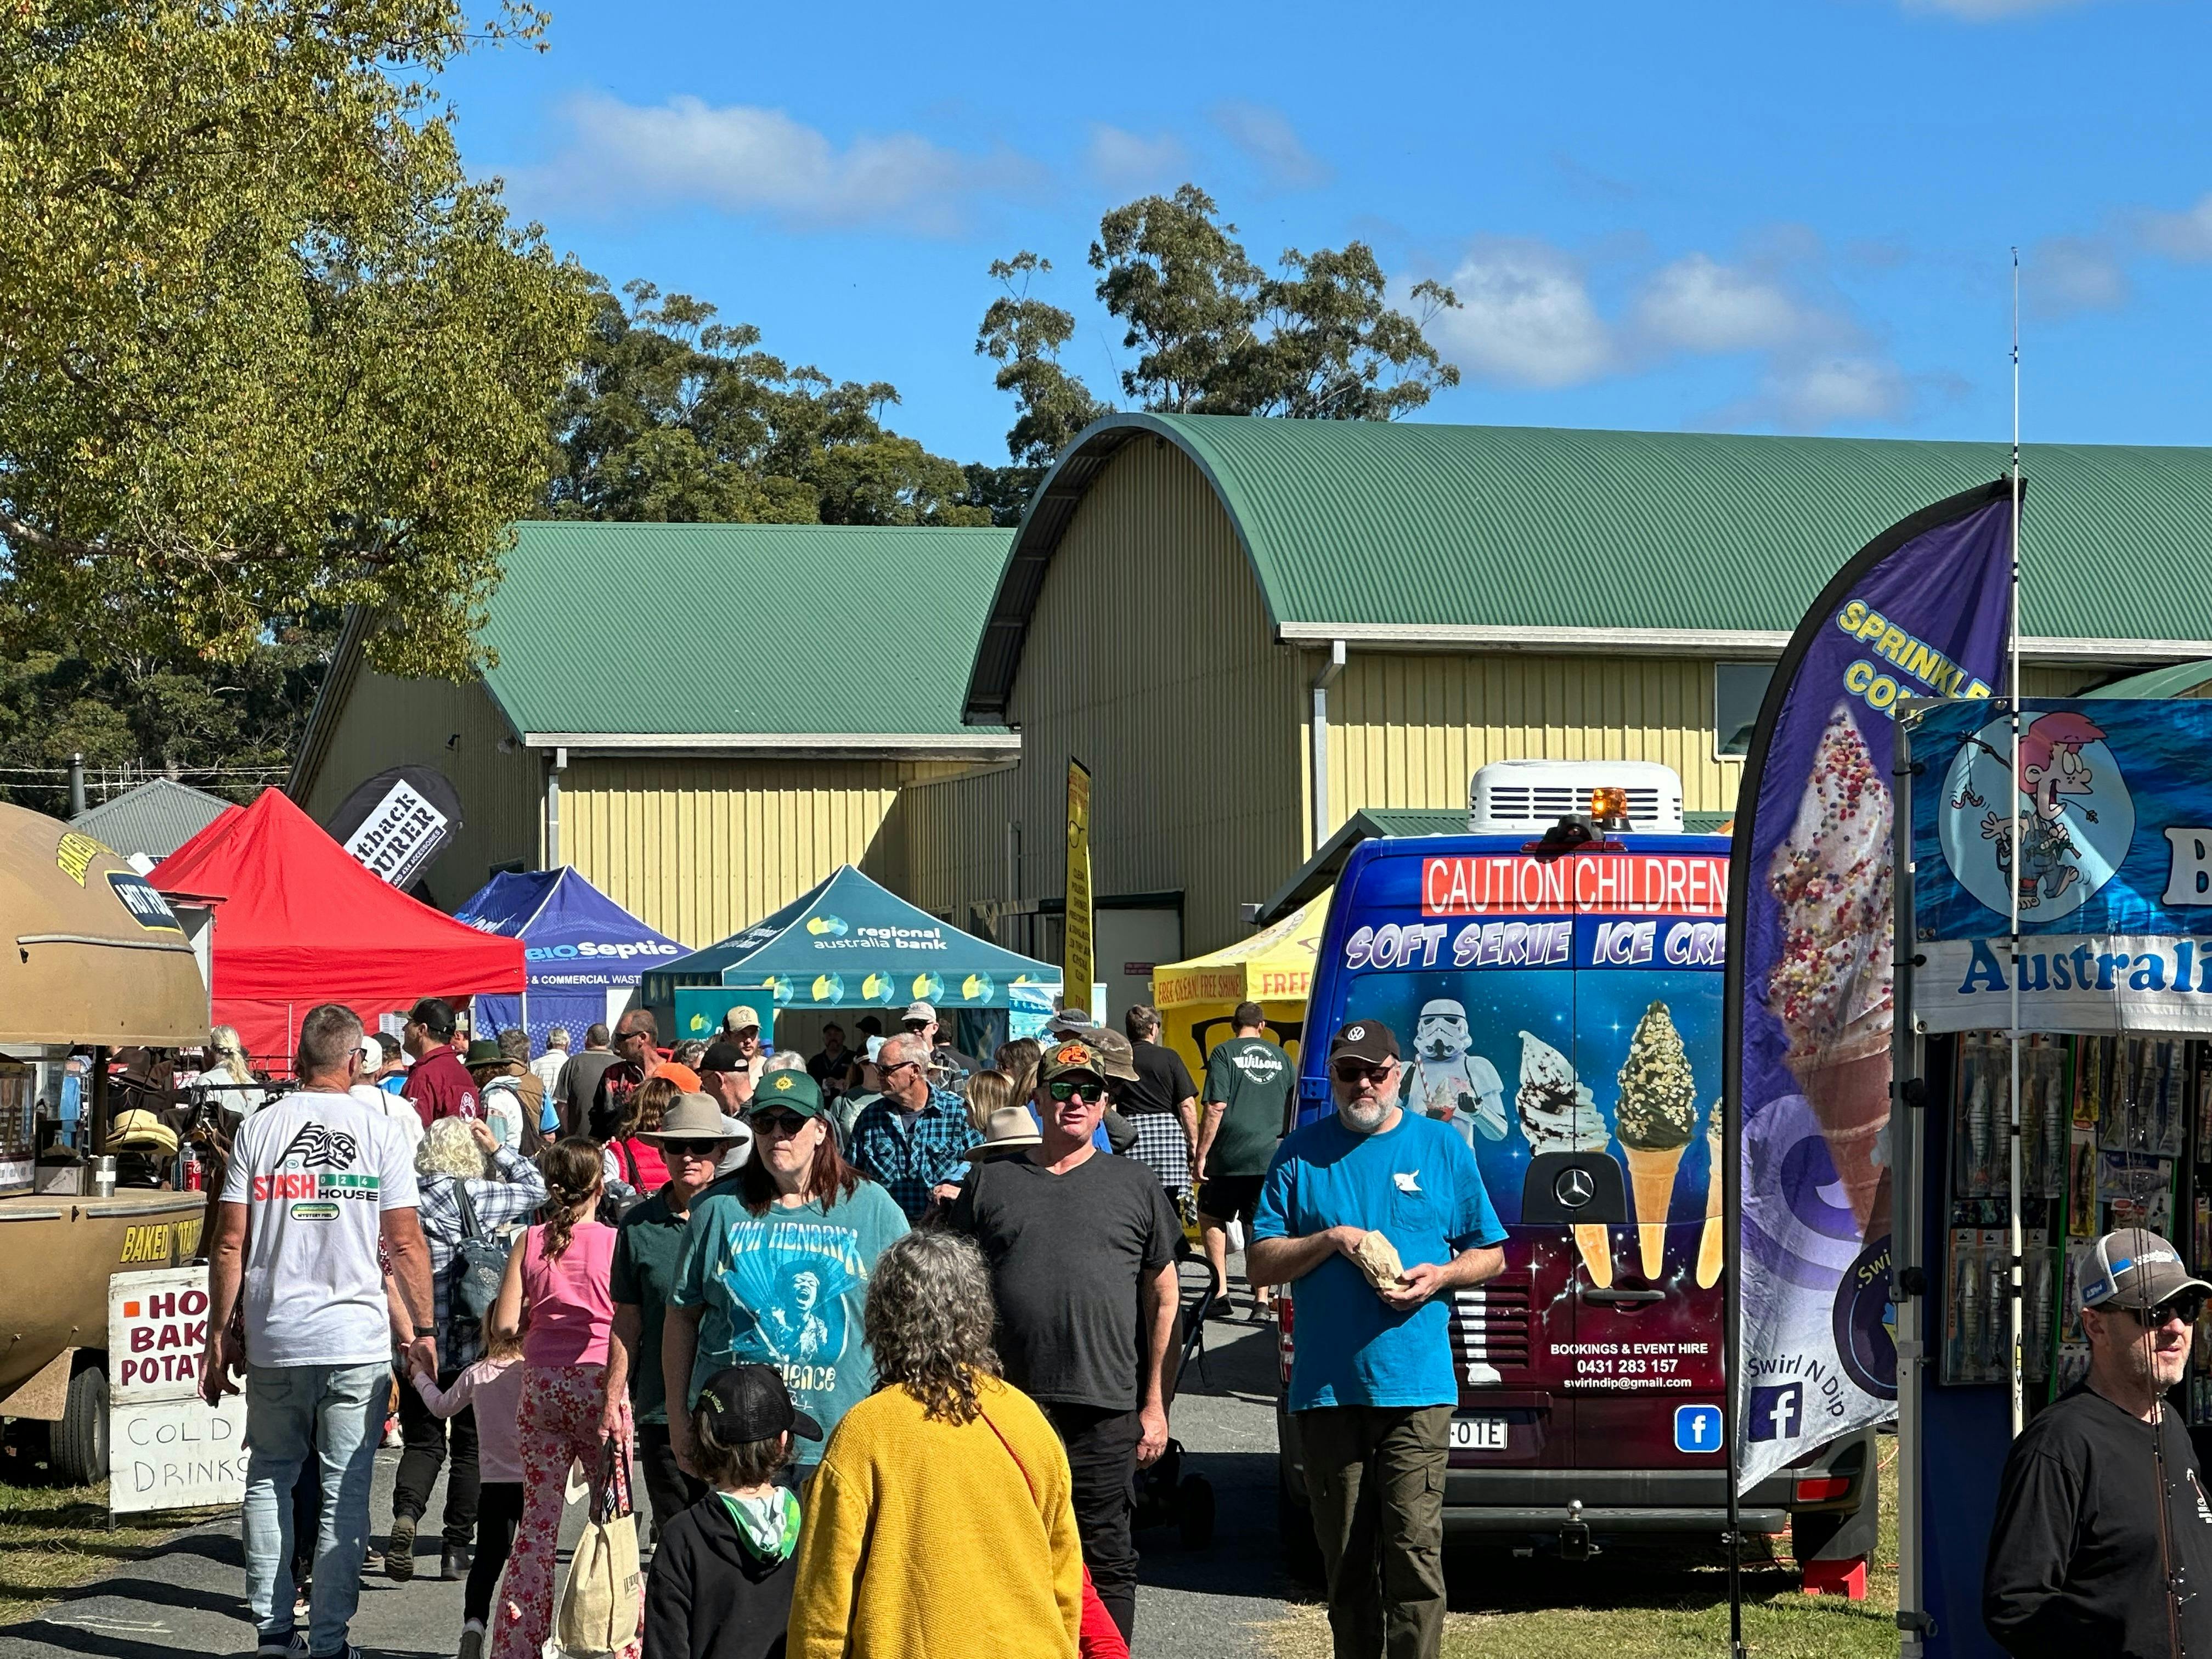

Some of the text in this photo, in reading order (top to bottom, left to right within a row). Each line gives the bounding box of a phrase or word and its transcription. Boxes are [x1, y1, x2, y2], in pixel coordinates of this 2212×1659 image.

[410, 829, 441, 865] ACCESSORIES
[1427, 857, 1729, 914] CAUTION CHILDREN
[814, 938, 948, 950] australia bank
[856, 926, 941, 939] regional
[1346, 923, 1447, 969] SOFT
[1453, 921, 1572, 968] SERVE
[1593, 922, 1657, 965] ICE
[525, 940, 678, 959] BIOSeptic
[531, 975, 539, 984] &
[541, 975, 610, 984] COMMERCIAL
[1158, 980, 1174, 1005] FREE
[1200, 974, 1217, 998] FREE
[1263, 972, 1310, 996] FREE
[254, 1174, 315, 1201] STASH
[318, 1189, 379, 1201] HOUSE
[120, 1223, 168, 1263] BAKED
[727, 1221, 868, 1281] JIMI HENDRIX
[1550, 1343, 1708, 1355] BOOKINGS & EVENT HIRE
[1577, 1359, 1678, 1373] 0431 283 157
[1748, 1354, 1846, 1417] Swirl N Dip
[128, 1418, 232, 1446] COLD
